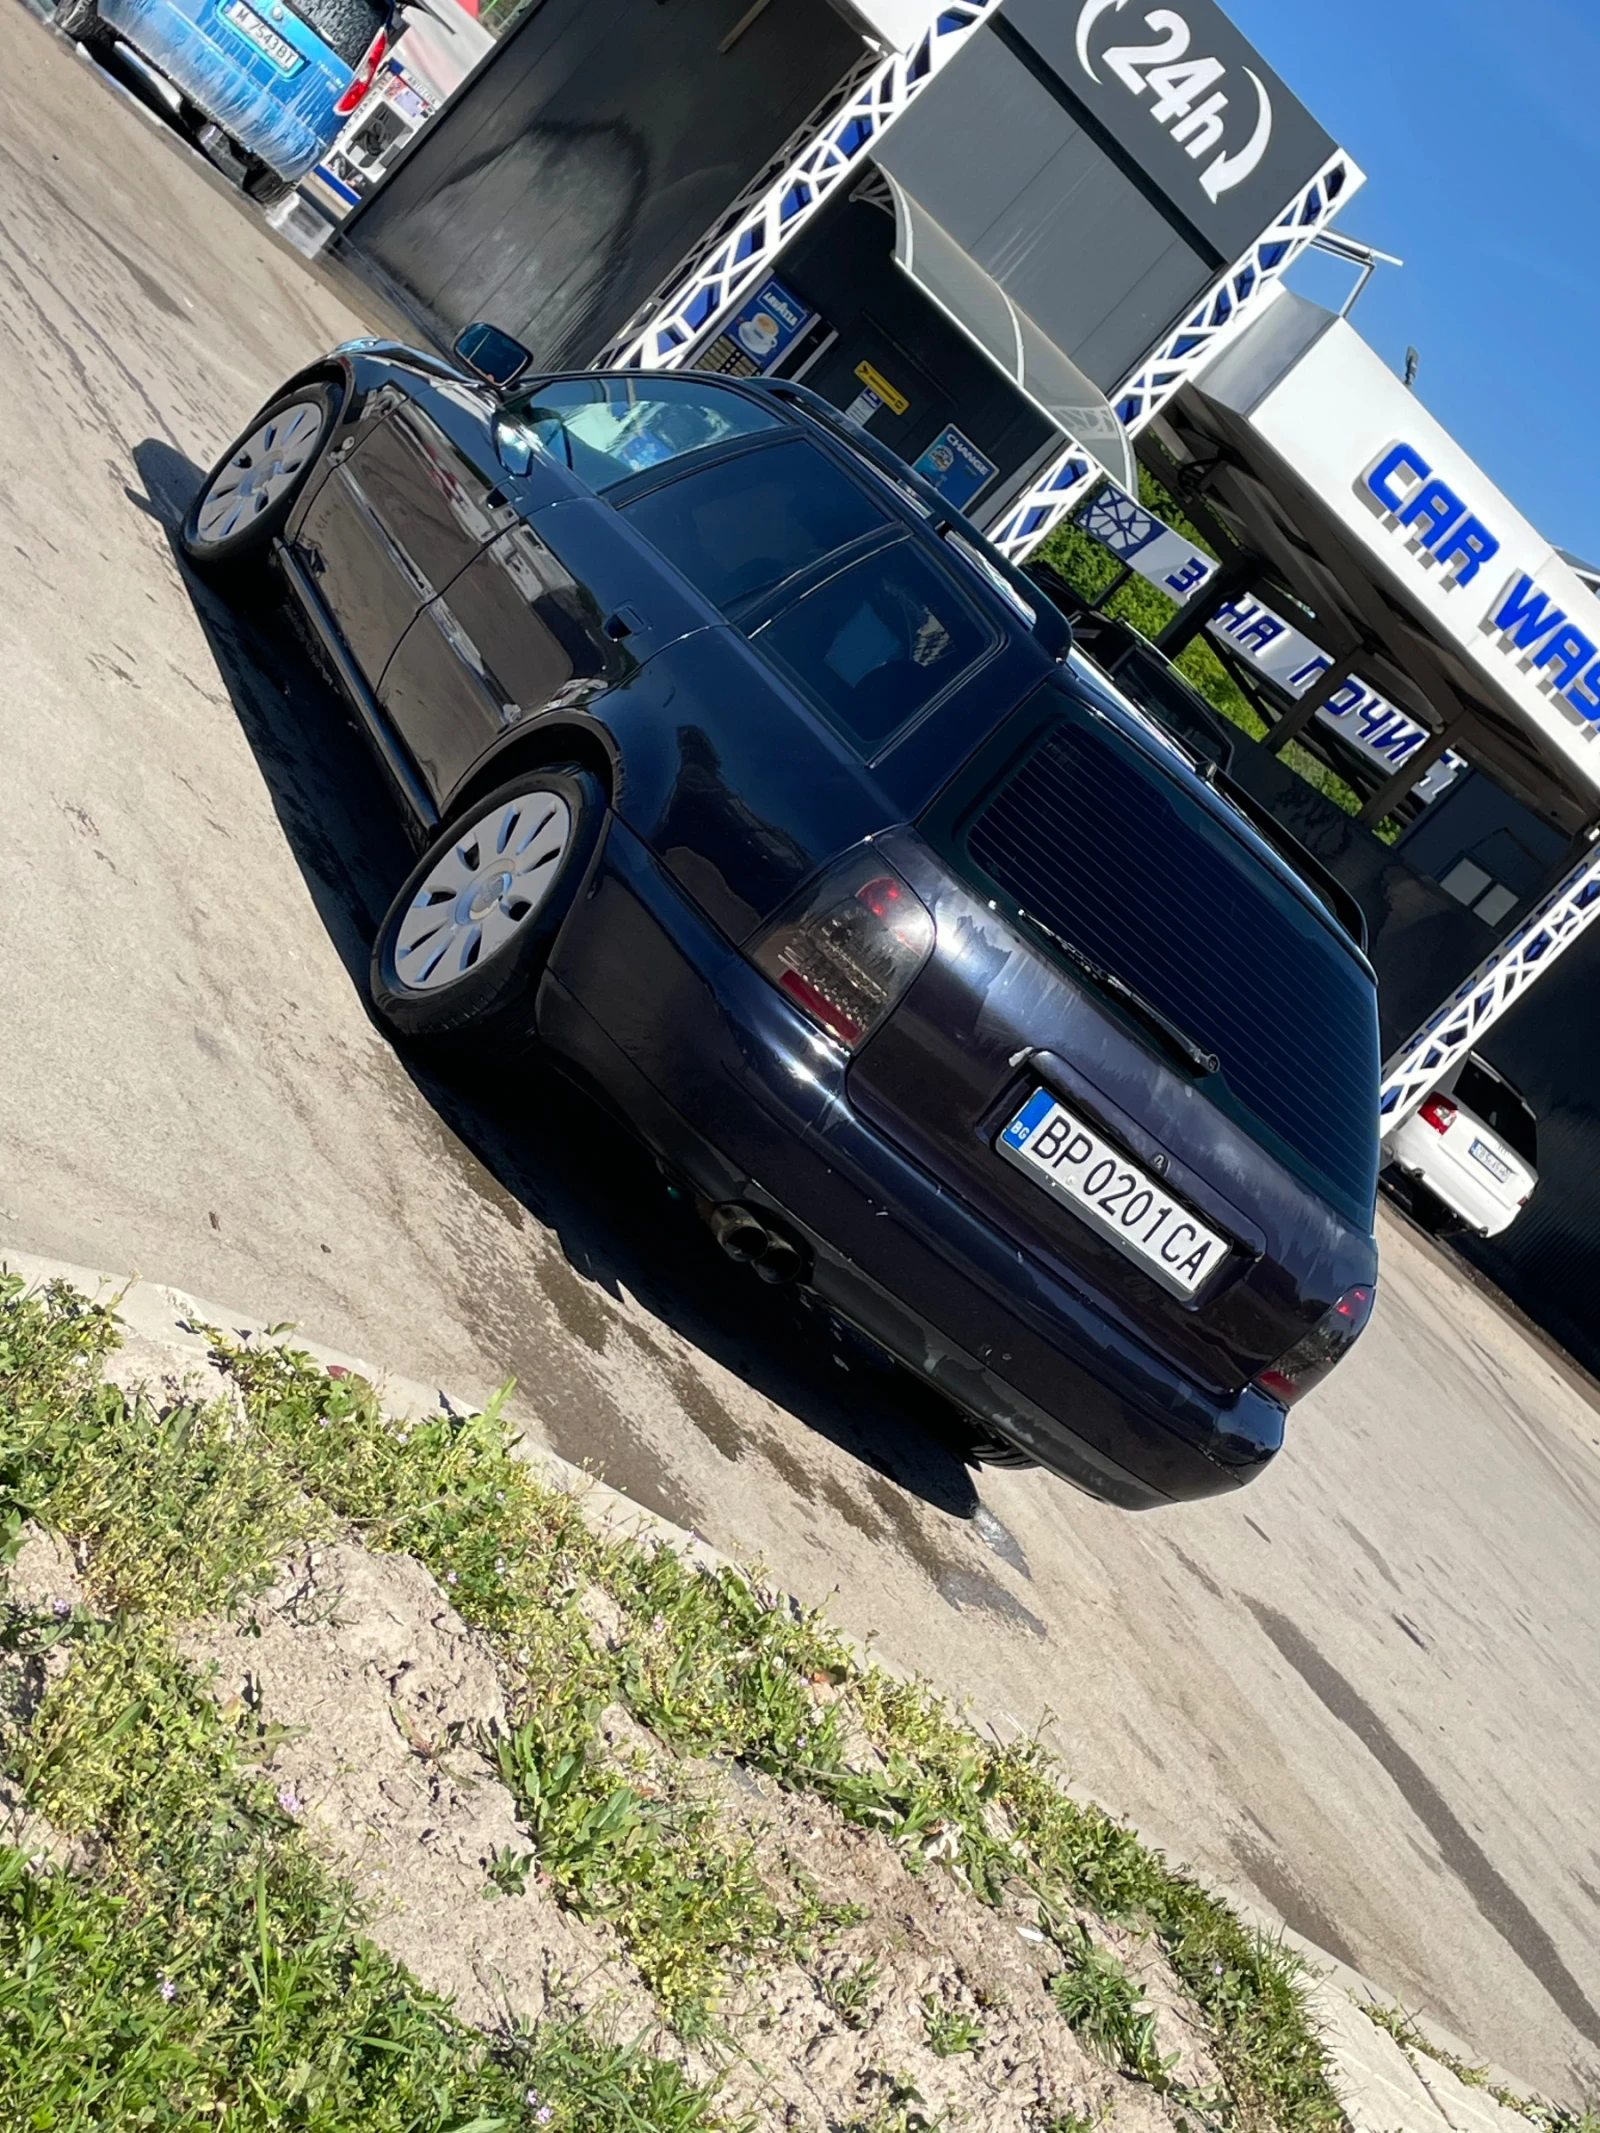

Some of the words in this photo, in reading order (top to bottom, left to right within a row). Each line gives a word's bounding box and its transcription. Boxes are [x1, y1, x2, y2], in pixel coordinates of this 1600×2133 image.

[1102, 9, 1229, 159] 24h
[946, 433, 989, 476] CHANGE
[1164, 556, 1285, 656] ЗНА
[1363, 440, 1500, 588] CAR
[1490, 569, 1600, 736] WAS
[1010, 1120, 1030, 1141] BG
